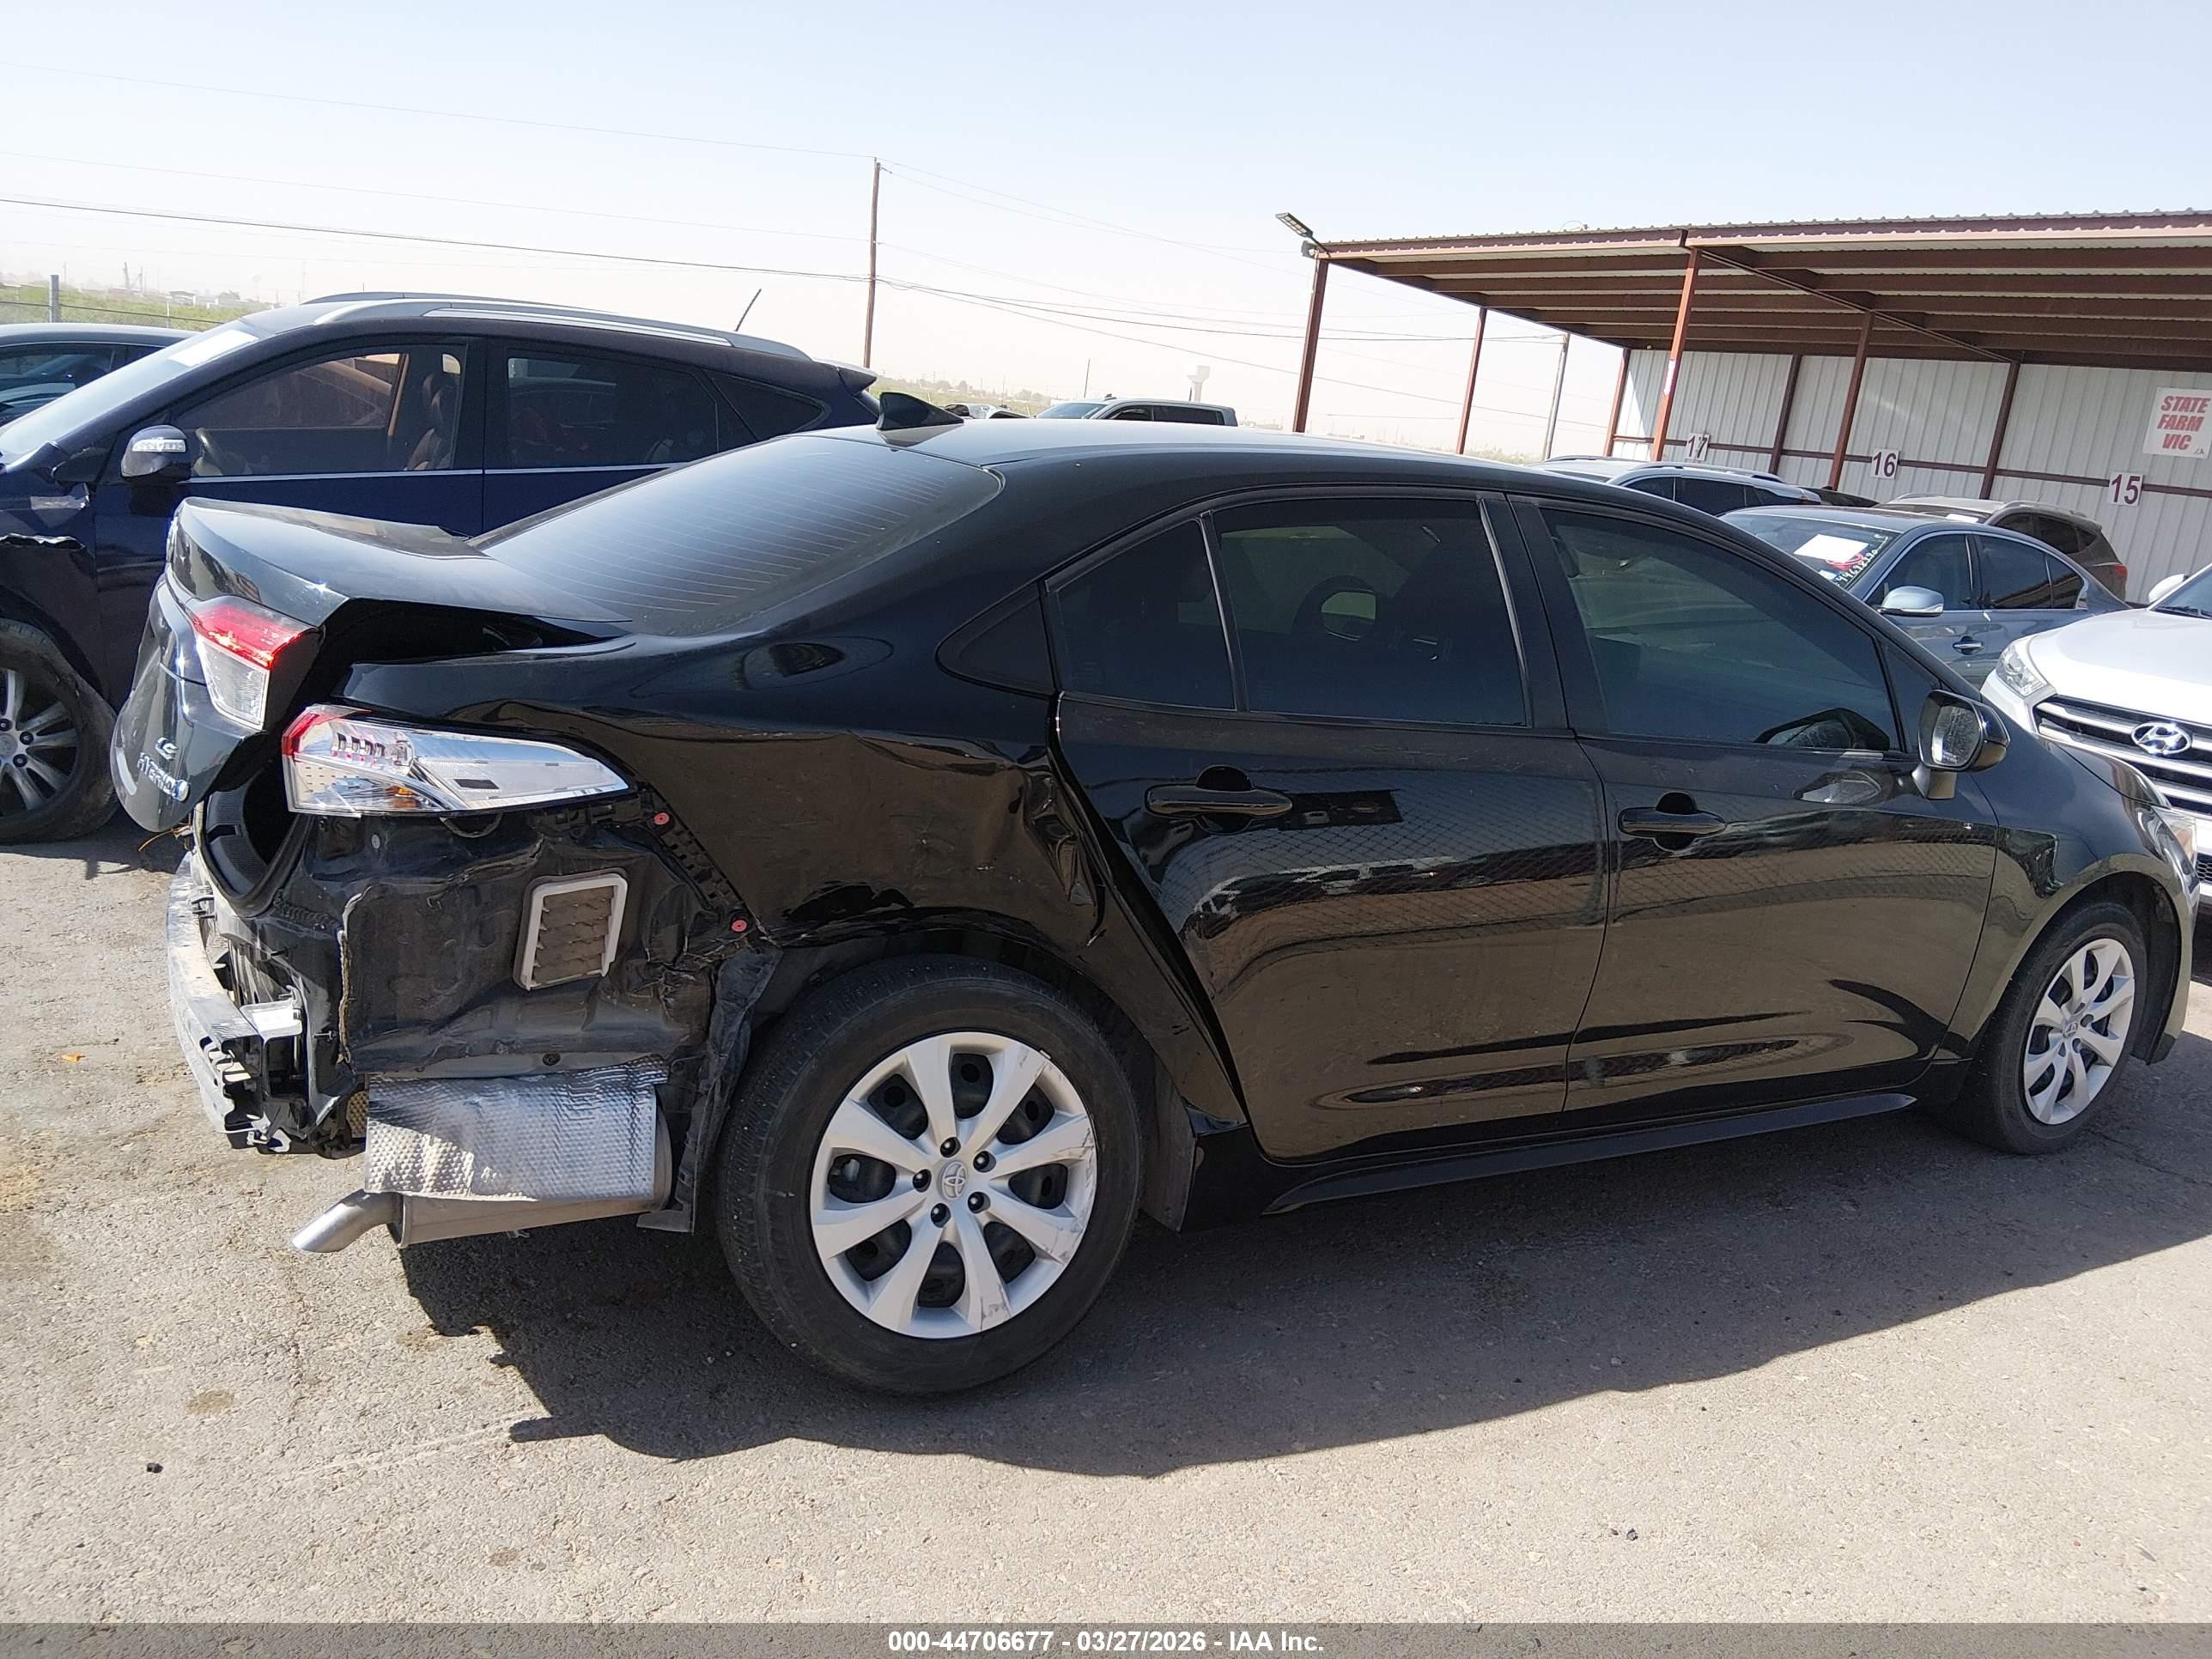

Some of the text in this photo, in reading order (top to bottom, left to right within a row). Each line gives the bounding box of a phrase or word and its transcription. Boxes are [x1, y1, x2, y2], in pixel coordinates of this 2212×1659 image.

[2160, 395, 2211, 413] STATE
[2156, 414, 2204, 432] FARM
[1688, 434, 1708, 459] 17
[2162, 433, 2192, 450] VIC
[1873, 451, 1897, 477] 16
[2112, 473, 2141, 505] 15
